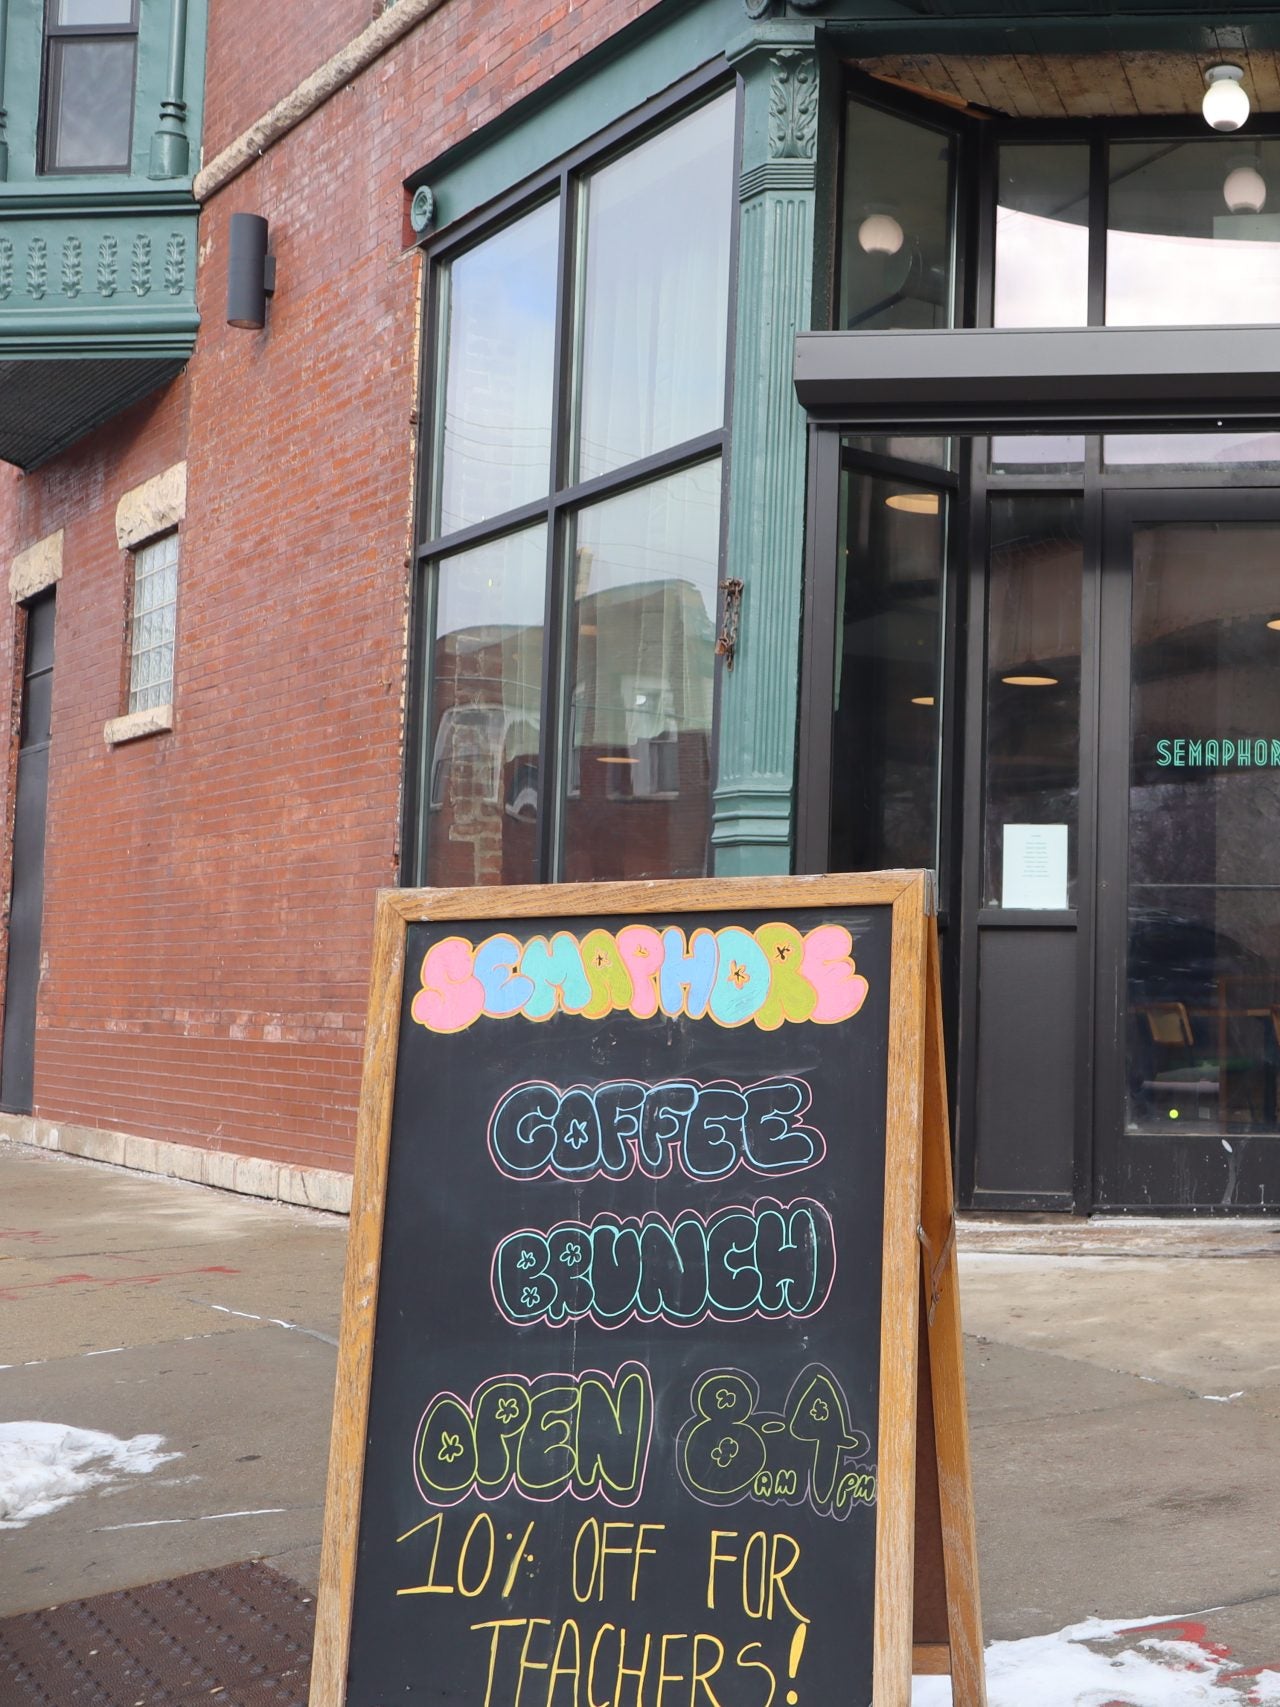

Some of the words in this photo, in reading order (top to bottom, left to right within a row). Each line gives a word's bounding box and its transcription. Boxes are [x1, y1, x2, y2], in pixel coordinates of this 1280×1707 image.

[411, 922, 869, 1034] SEMAPHORE
[488, 1077, 826, 1181] COFFEE
[491, 1197, 836, 1329] BRUNCH
[413, 1361, 653, 1507] OPEN
[396, 1513, 536, 1598] 10%
[573, 1513, 665, 1602] OFF
[707, 1530, 811, 1623] FOR
[470, 1618, 807, 1707] TEACHERS!
